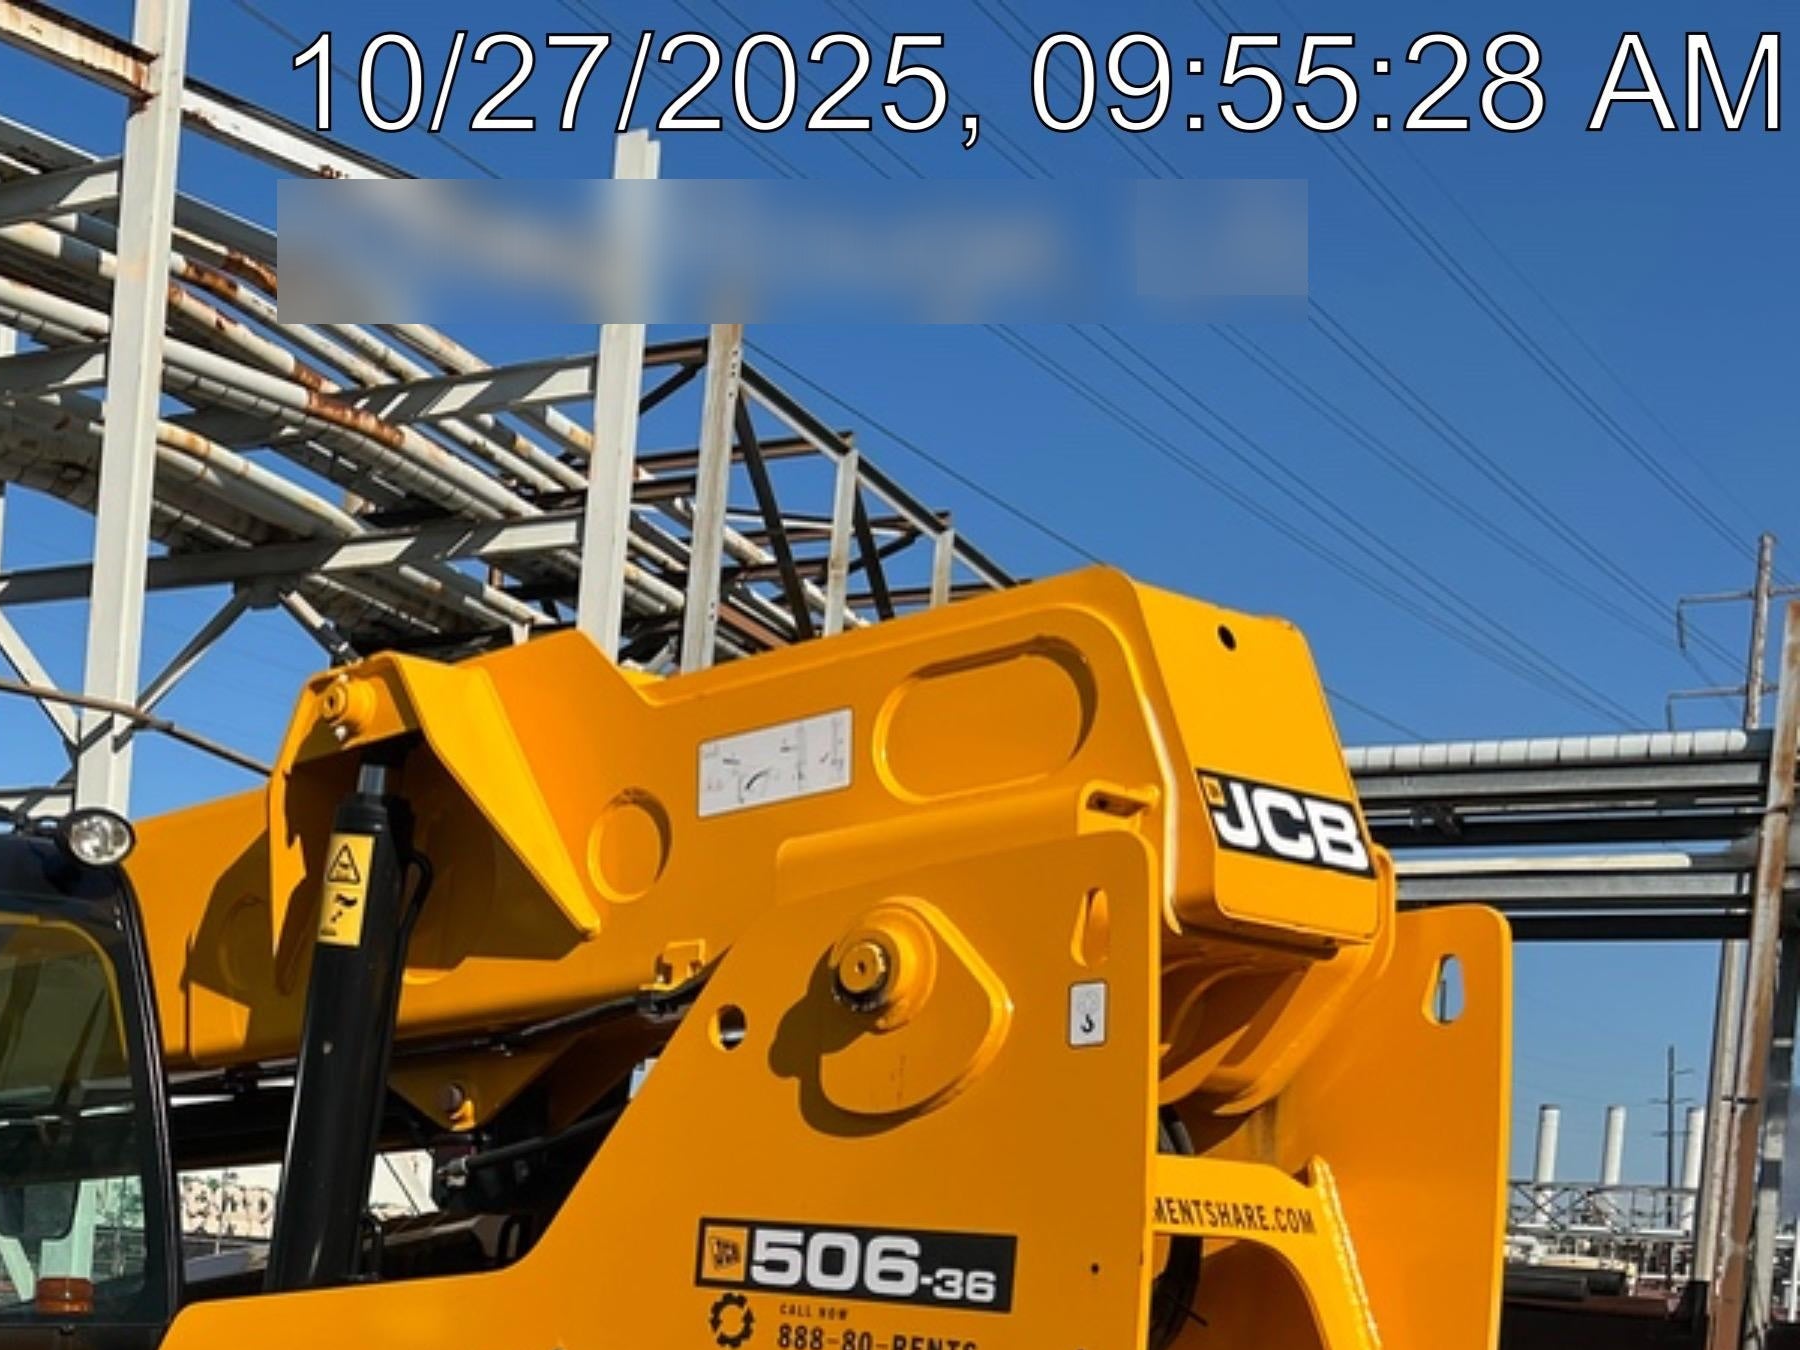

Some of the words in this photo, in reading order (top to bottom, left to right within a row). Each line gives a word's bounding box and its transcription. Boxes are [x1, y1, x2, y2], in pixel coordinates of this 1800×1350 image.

[1213, 781, 1369, 870] JCB
[750, 1228, 997, 1303] 506-36
[779, 1303, 813, 1318] CALL
[819, 1306, 849, 1320] NOW
